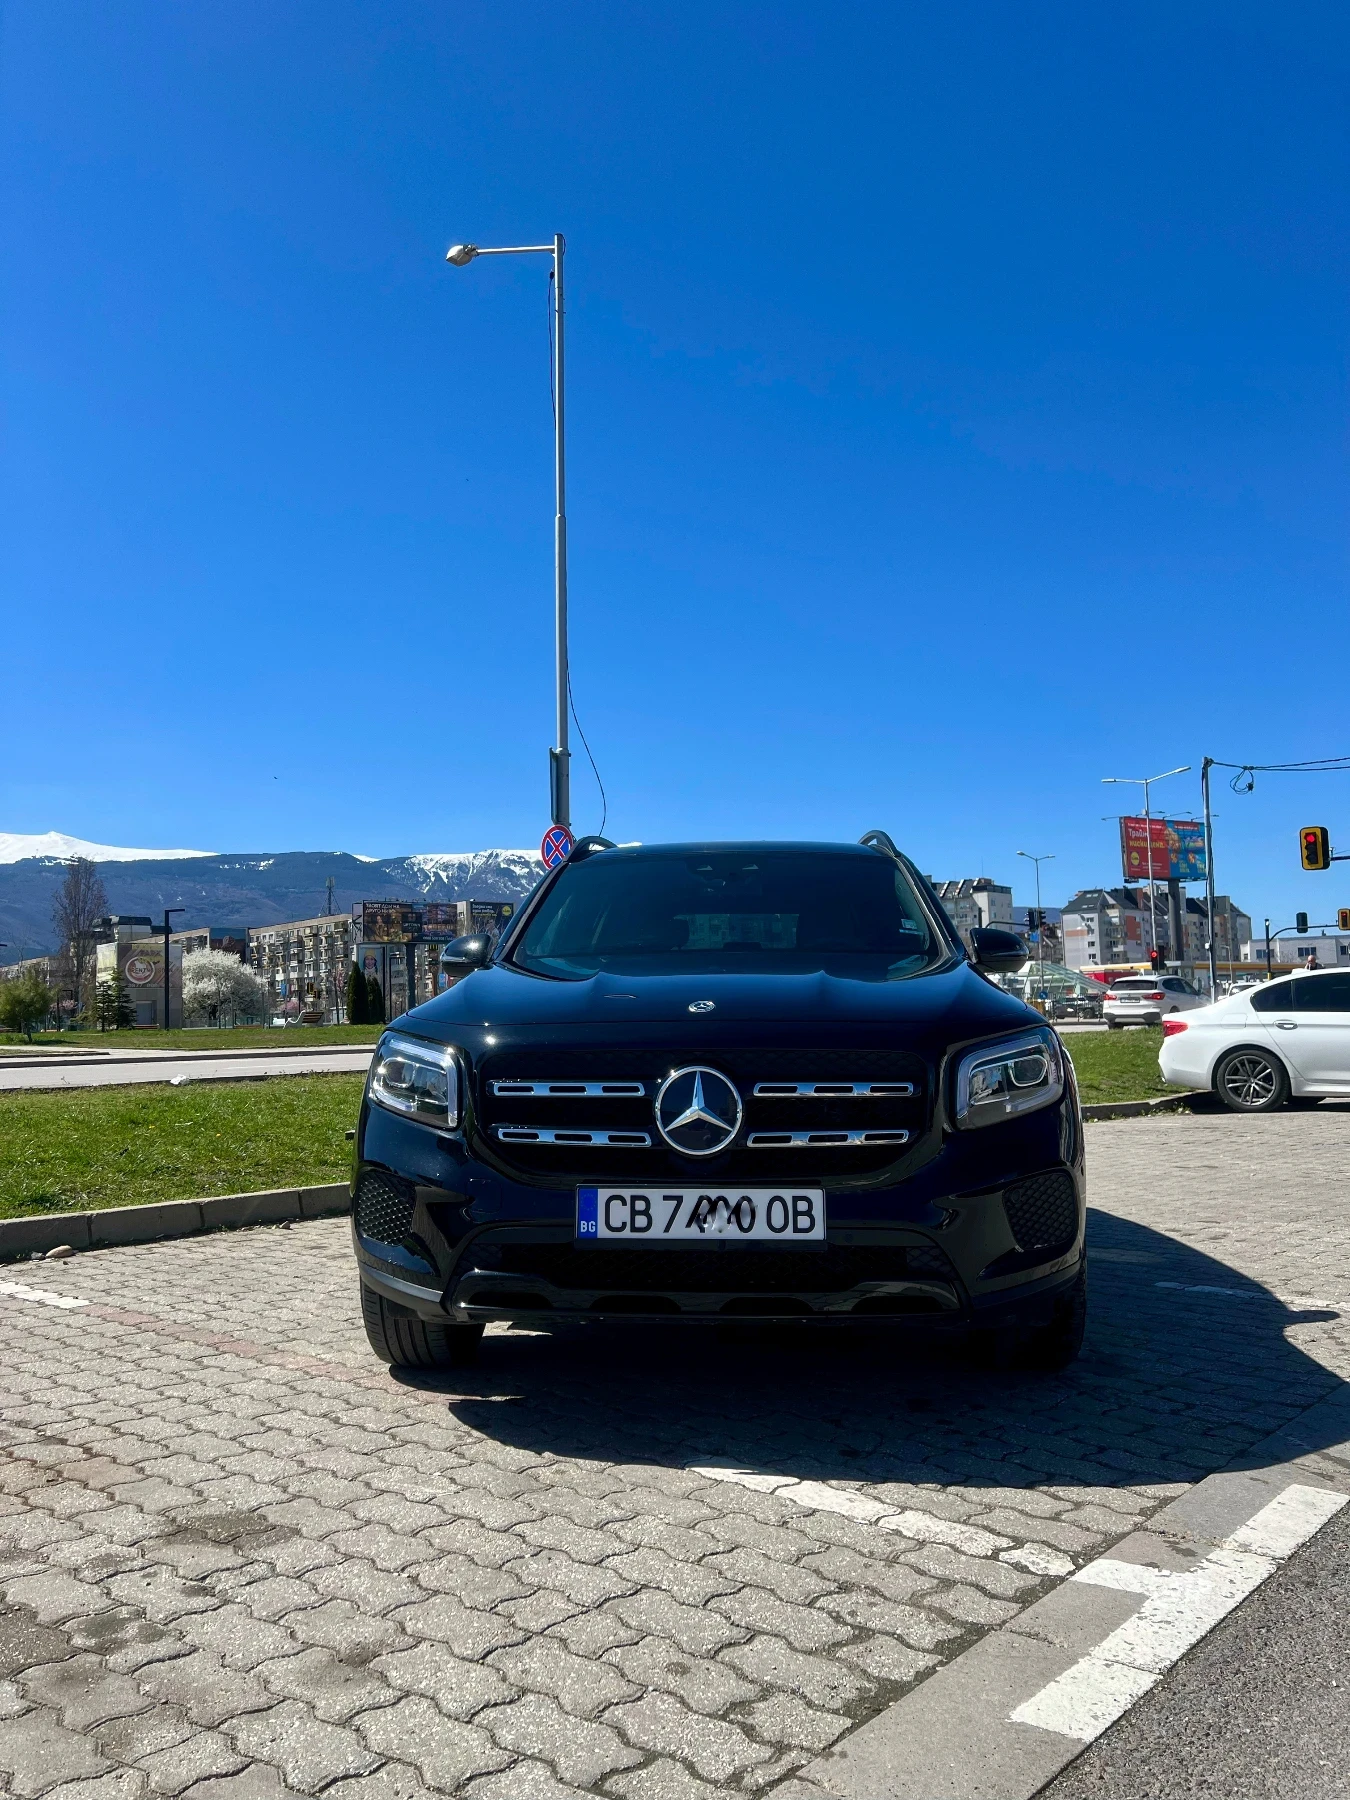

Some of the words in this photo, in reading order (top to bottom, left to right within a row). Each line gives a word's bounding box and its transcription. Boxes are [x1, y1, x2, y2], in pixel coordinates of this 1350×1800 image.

[1128, 828, 1149, 838] Трайн
[604, 1195, 653, 1233] CB
[766, 1195, 816, 1234] OB
[580, 1220, 596, 1233] BG
